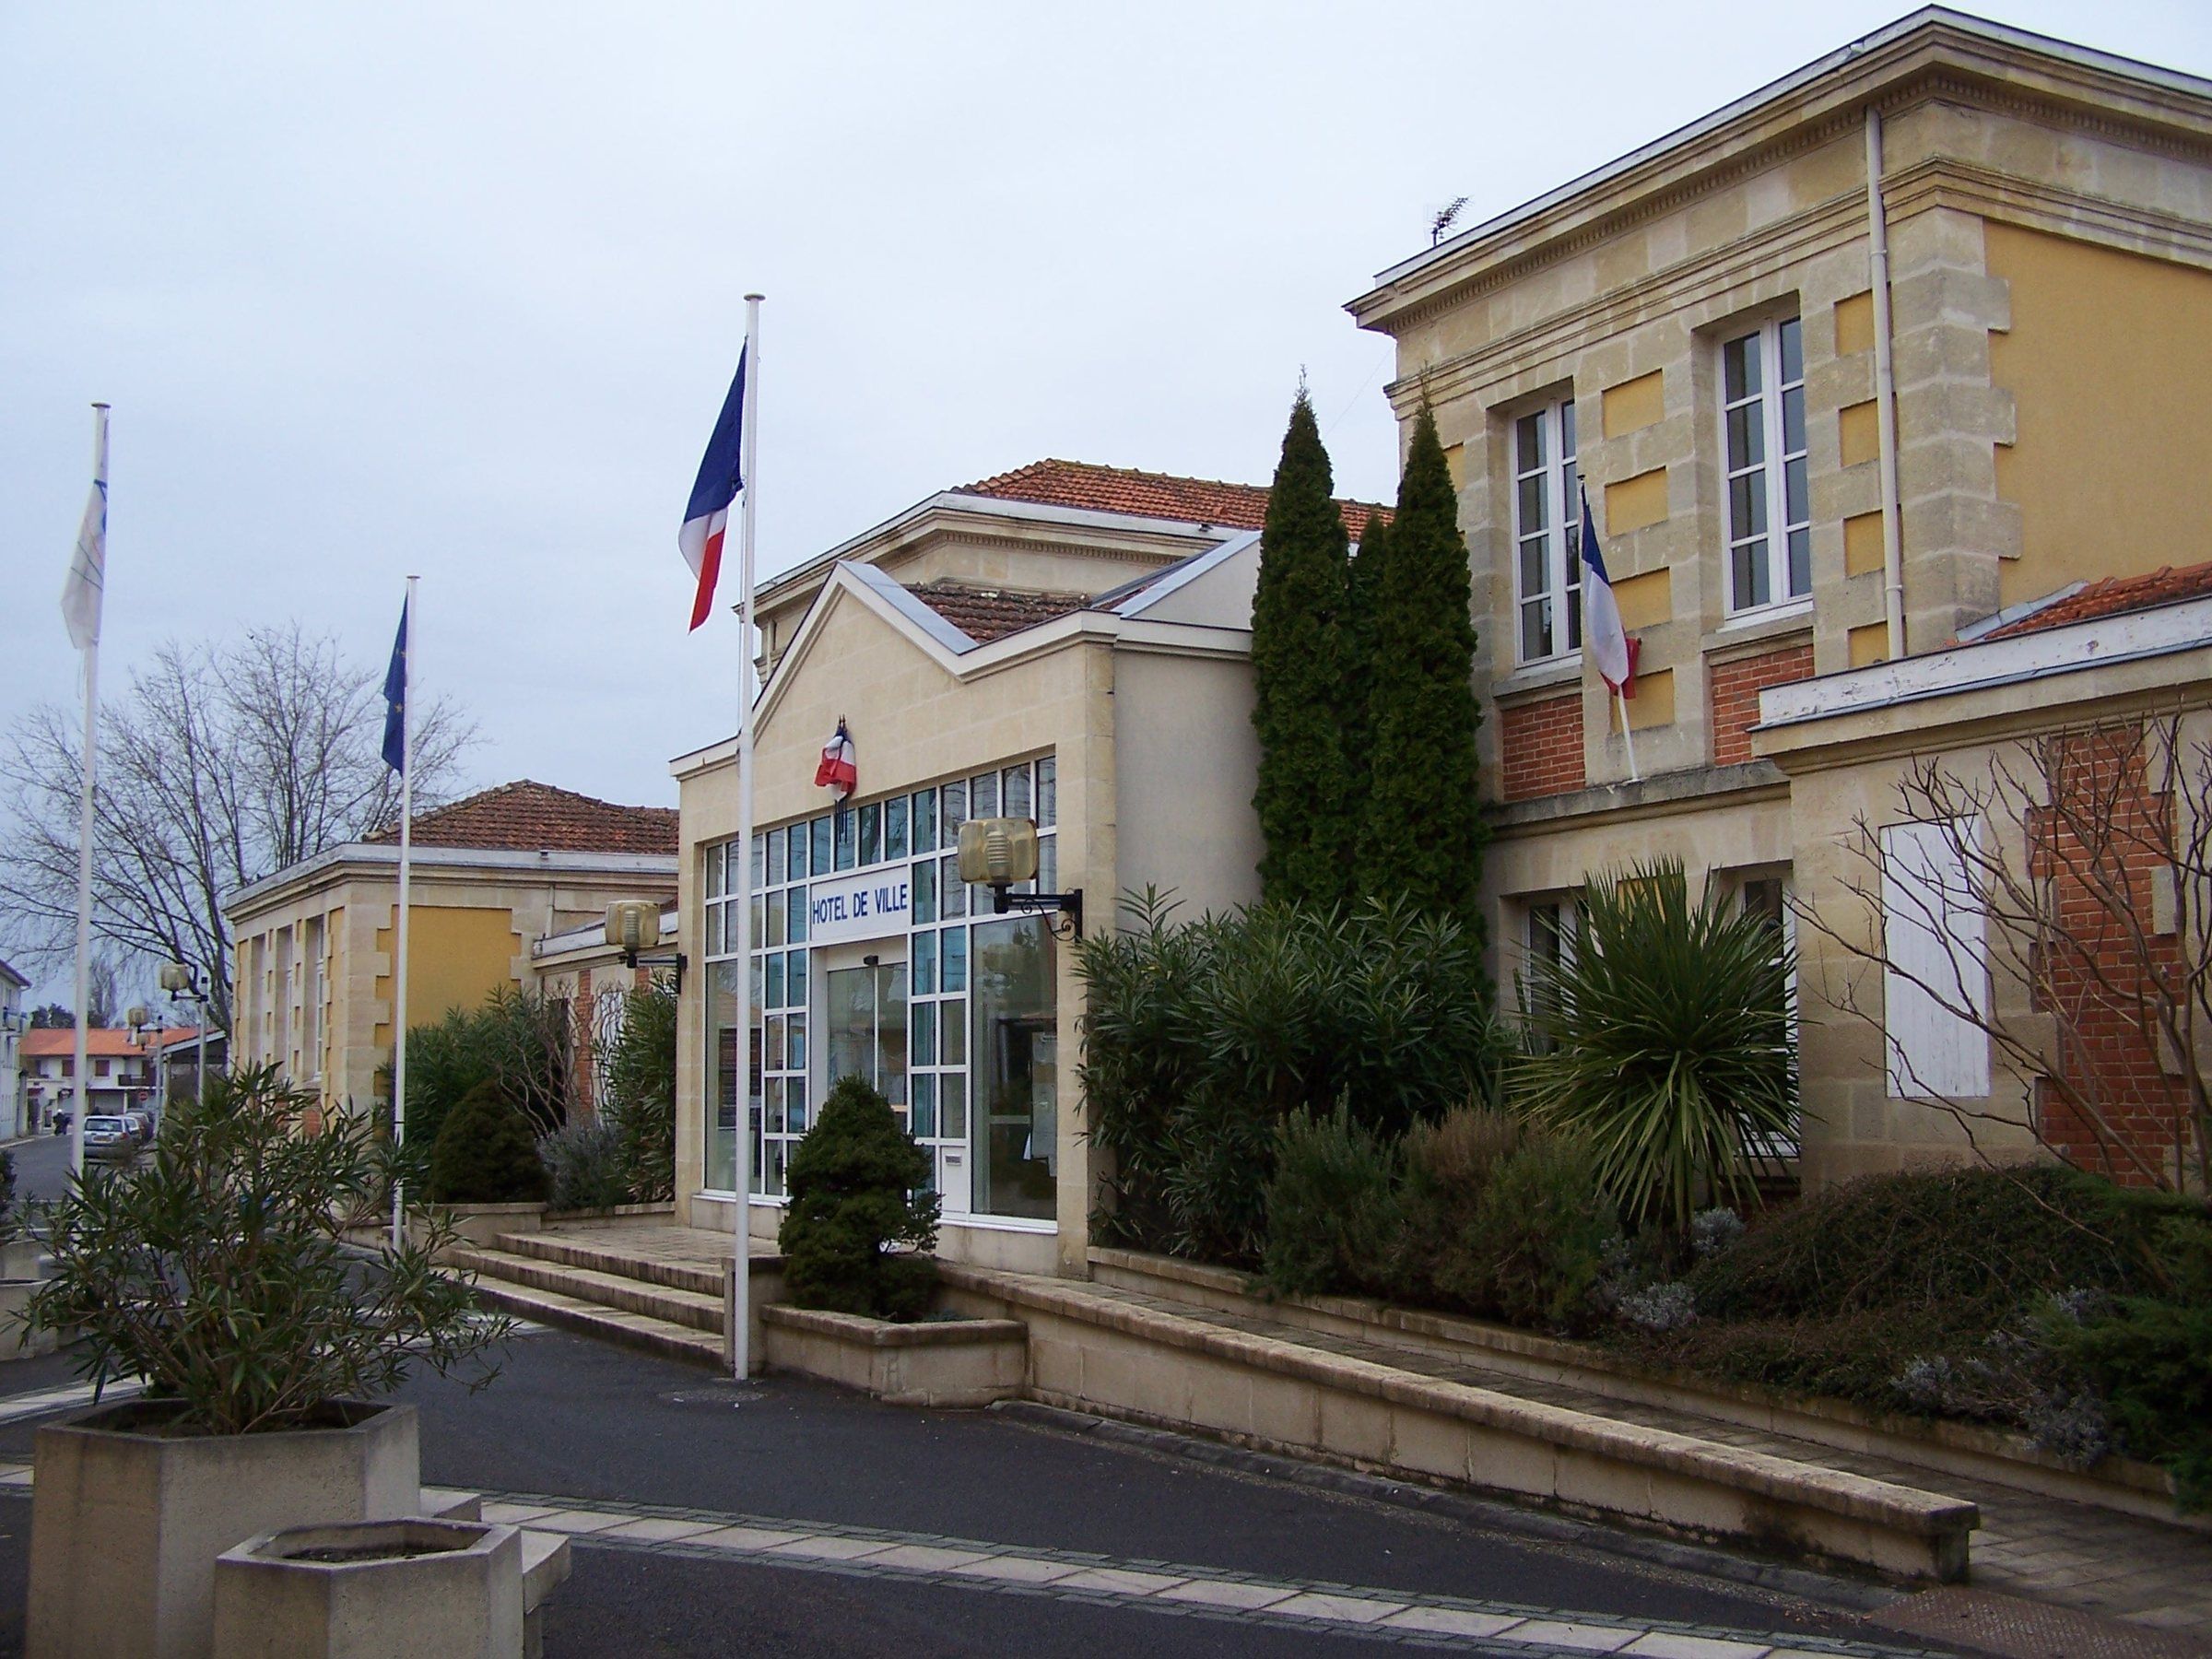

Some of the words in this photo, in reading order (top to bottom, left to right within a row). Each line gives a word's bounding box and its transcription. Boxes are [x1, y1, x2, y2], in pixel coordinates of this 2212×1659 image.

[812, 895, 848, 924] HOTEL
[853, 890, 868, 917] DE
[875, 884, 908, 913] VILLE
